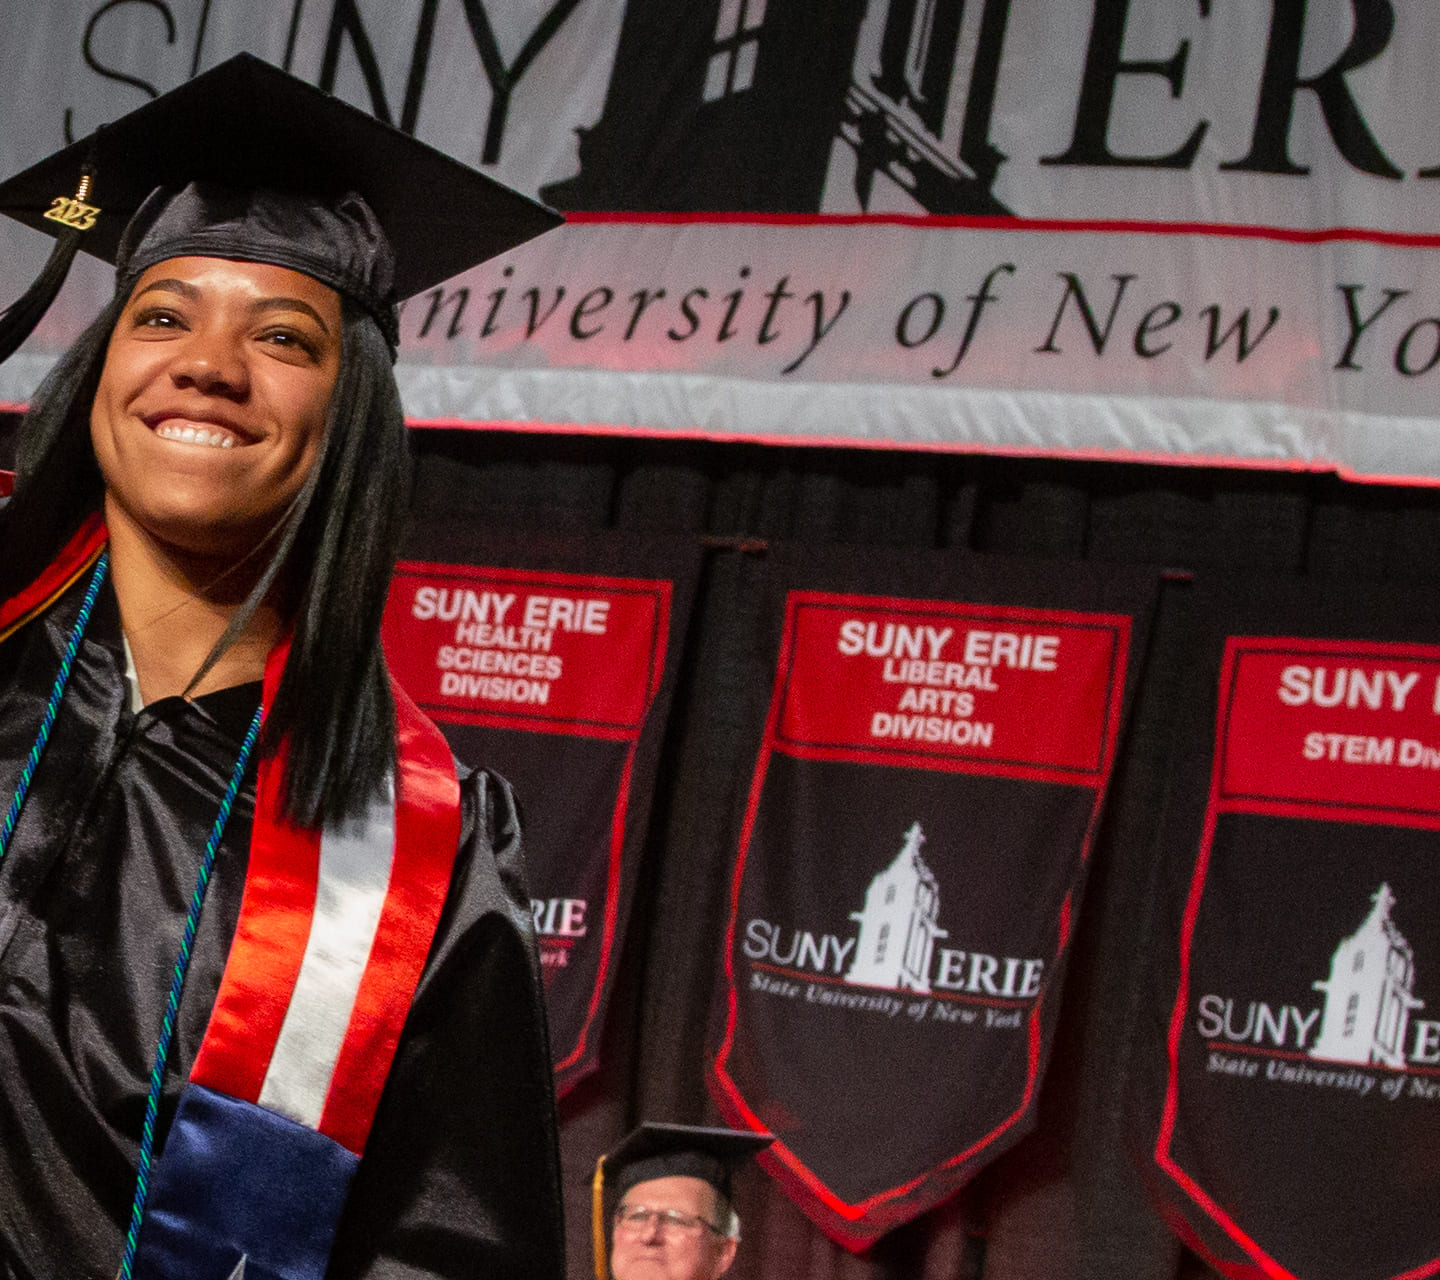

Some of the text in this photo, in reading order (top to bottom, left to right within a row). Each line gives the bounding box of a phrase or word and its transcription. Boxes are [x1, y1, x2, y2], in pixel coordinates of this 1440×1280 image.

[397, 265, 852, 376] niversity
[893, 263, 1017, 378] of
[1033, 272, 1282, 365] New
[412, 586, 611, 635] SUNY ERIE
[455, 621, 555, 652] HEALTH
[837, 619, 1060, 671] SUNY ERIE
[436, 645, 563, 680] SCIENCES
[882, 658, 999, 691] LIBERAL
[440, 671, 551, 705] DIVISION
[897, 687, 975, 718] ARTS
[1278, 664, 1420, 712] SUNY
[870, 711, 995, 748] DIVISION
[1302, 731, 1396, 765] STEM
[529, 898, 588, 937] RIE
[742, 918, 1045, 998] SUNY ERIE
[748, 972, 1024, 1029] State University of New York
[1197, 994, 1320, 1048] SUNY
[1206, 1053, 1259, 1078] State
[1266, 1059, 1376, 1098] University
[1379, 1074, 1407, 1101] of
